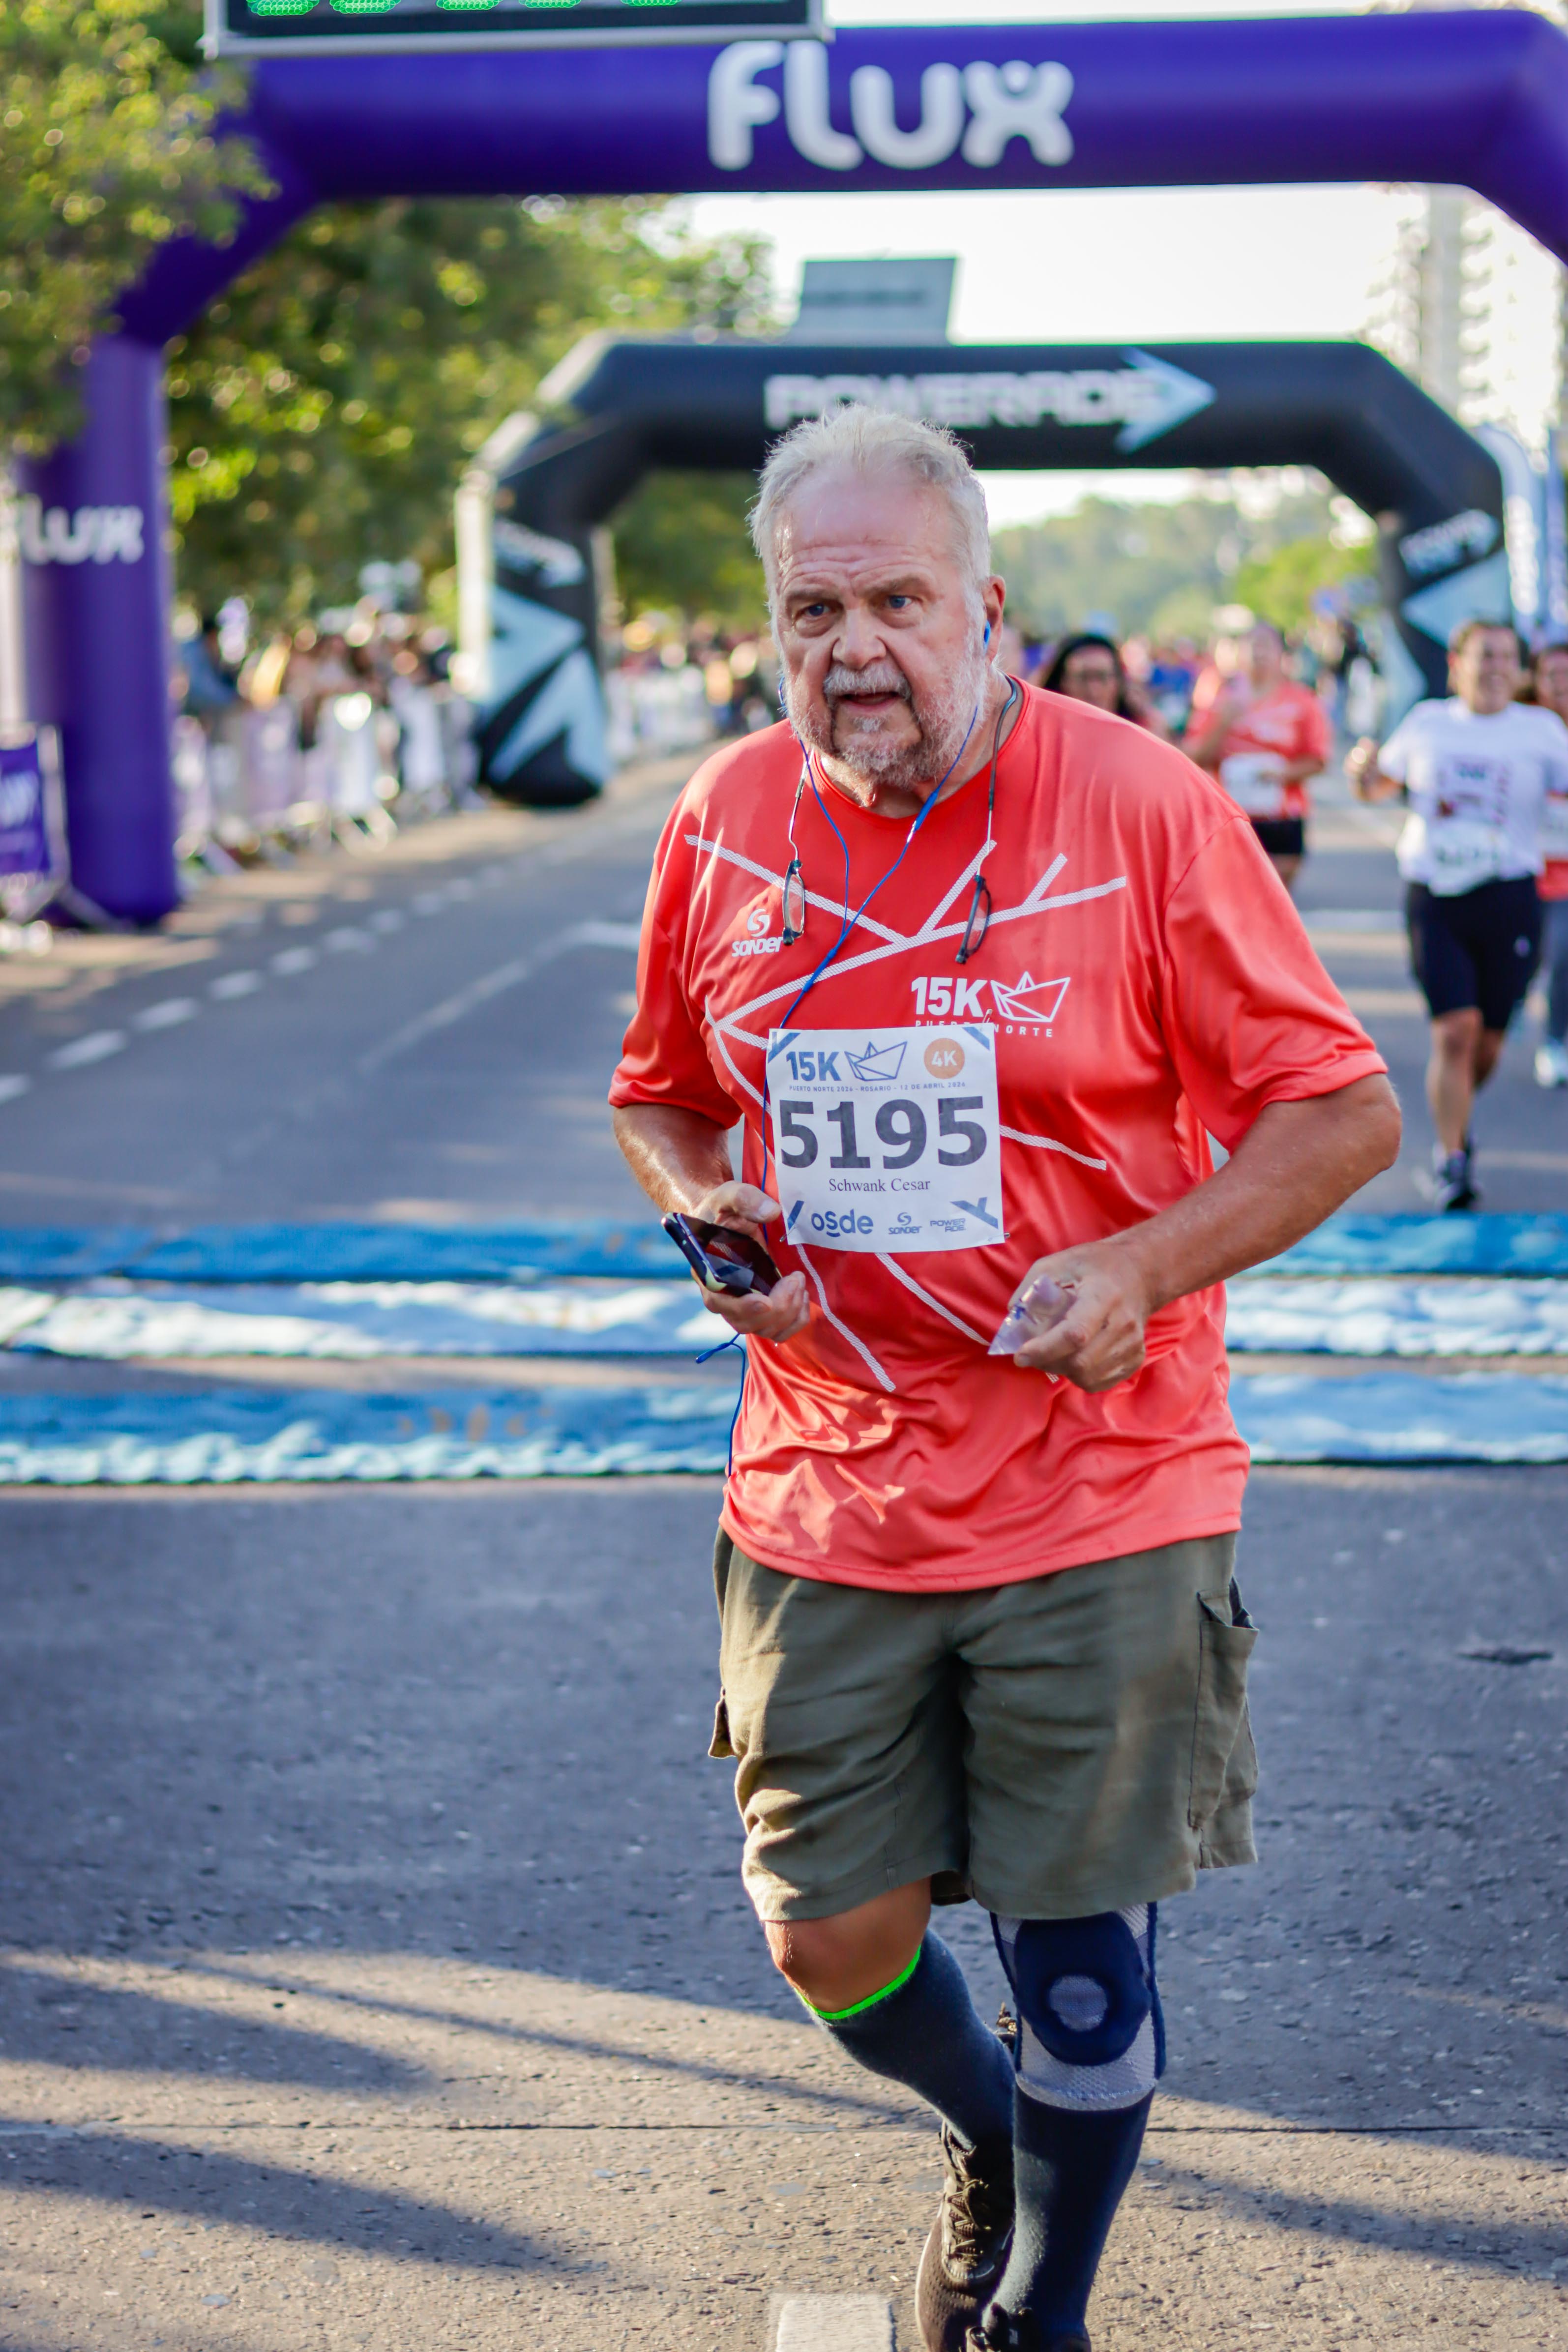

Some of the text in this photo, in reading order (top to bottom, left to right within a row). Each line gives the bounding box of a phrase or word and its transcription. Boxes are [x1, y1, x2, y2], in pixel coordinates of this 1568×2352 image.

[911, 976, 988, 1017] 15K
[992, 1024, 1052, 1037] NORTE
[786, 1051, 842, 1082] 15K
[932, 1050, 957, 1067] 4K
[779, 1096, 987, 1169] 5195
[828, 1178, 930, 1192] Schwank Cesar
[811, 1209, 874, 1237] osde
[930, 1218, 966, 1227] POWER
